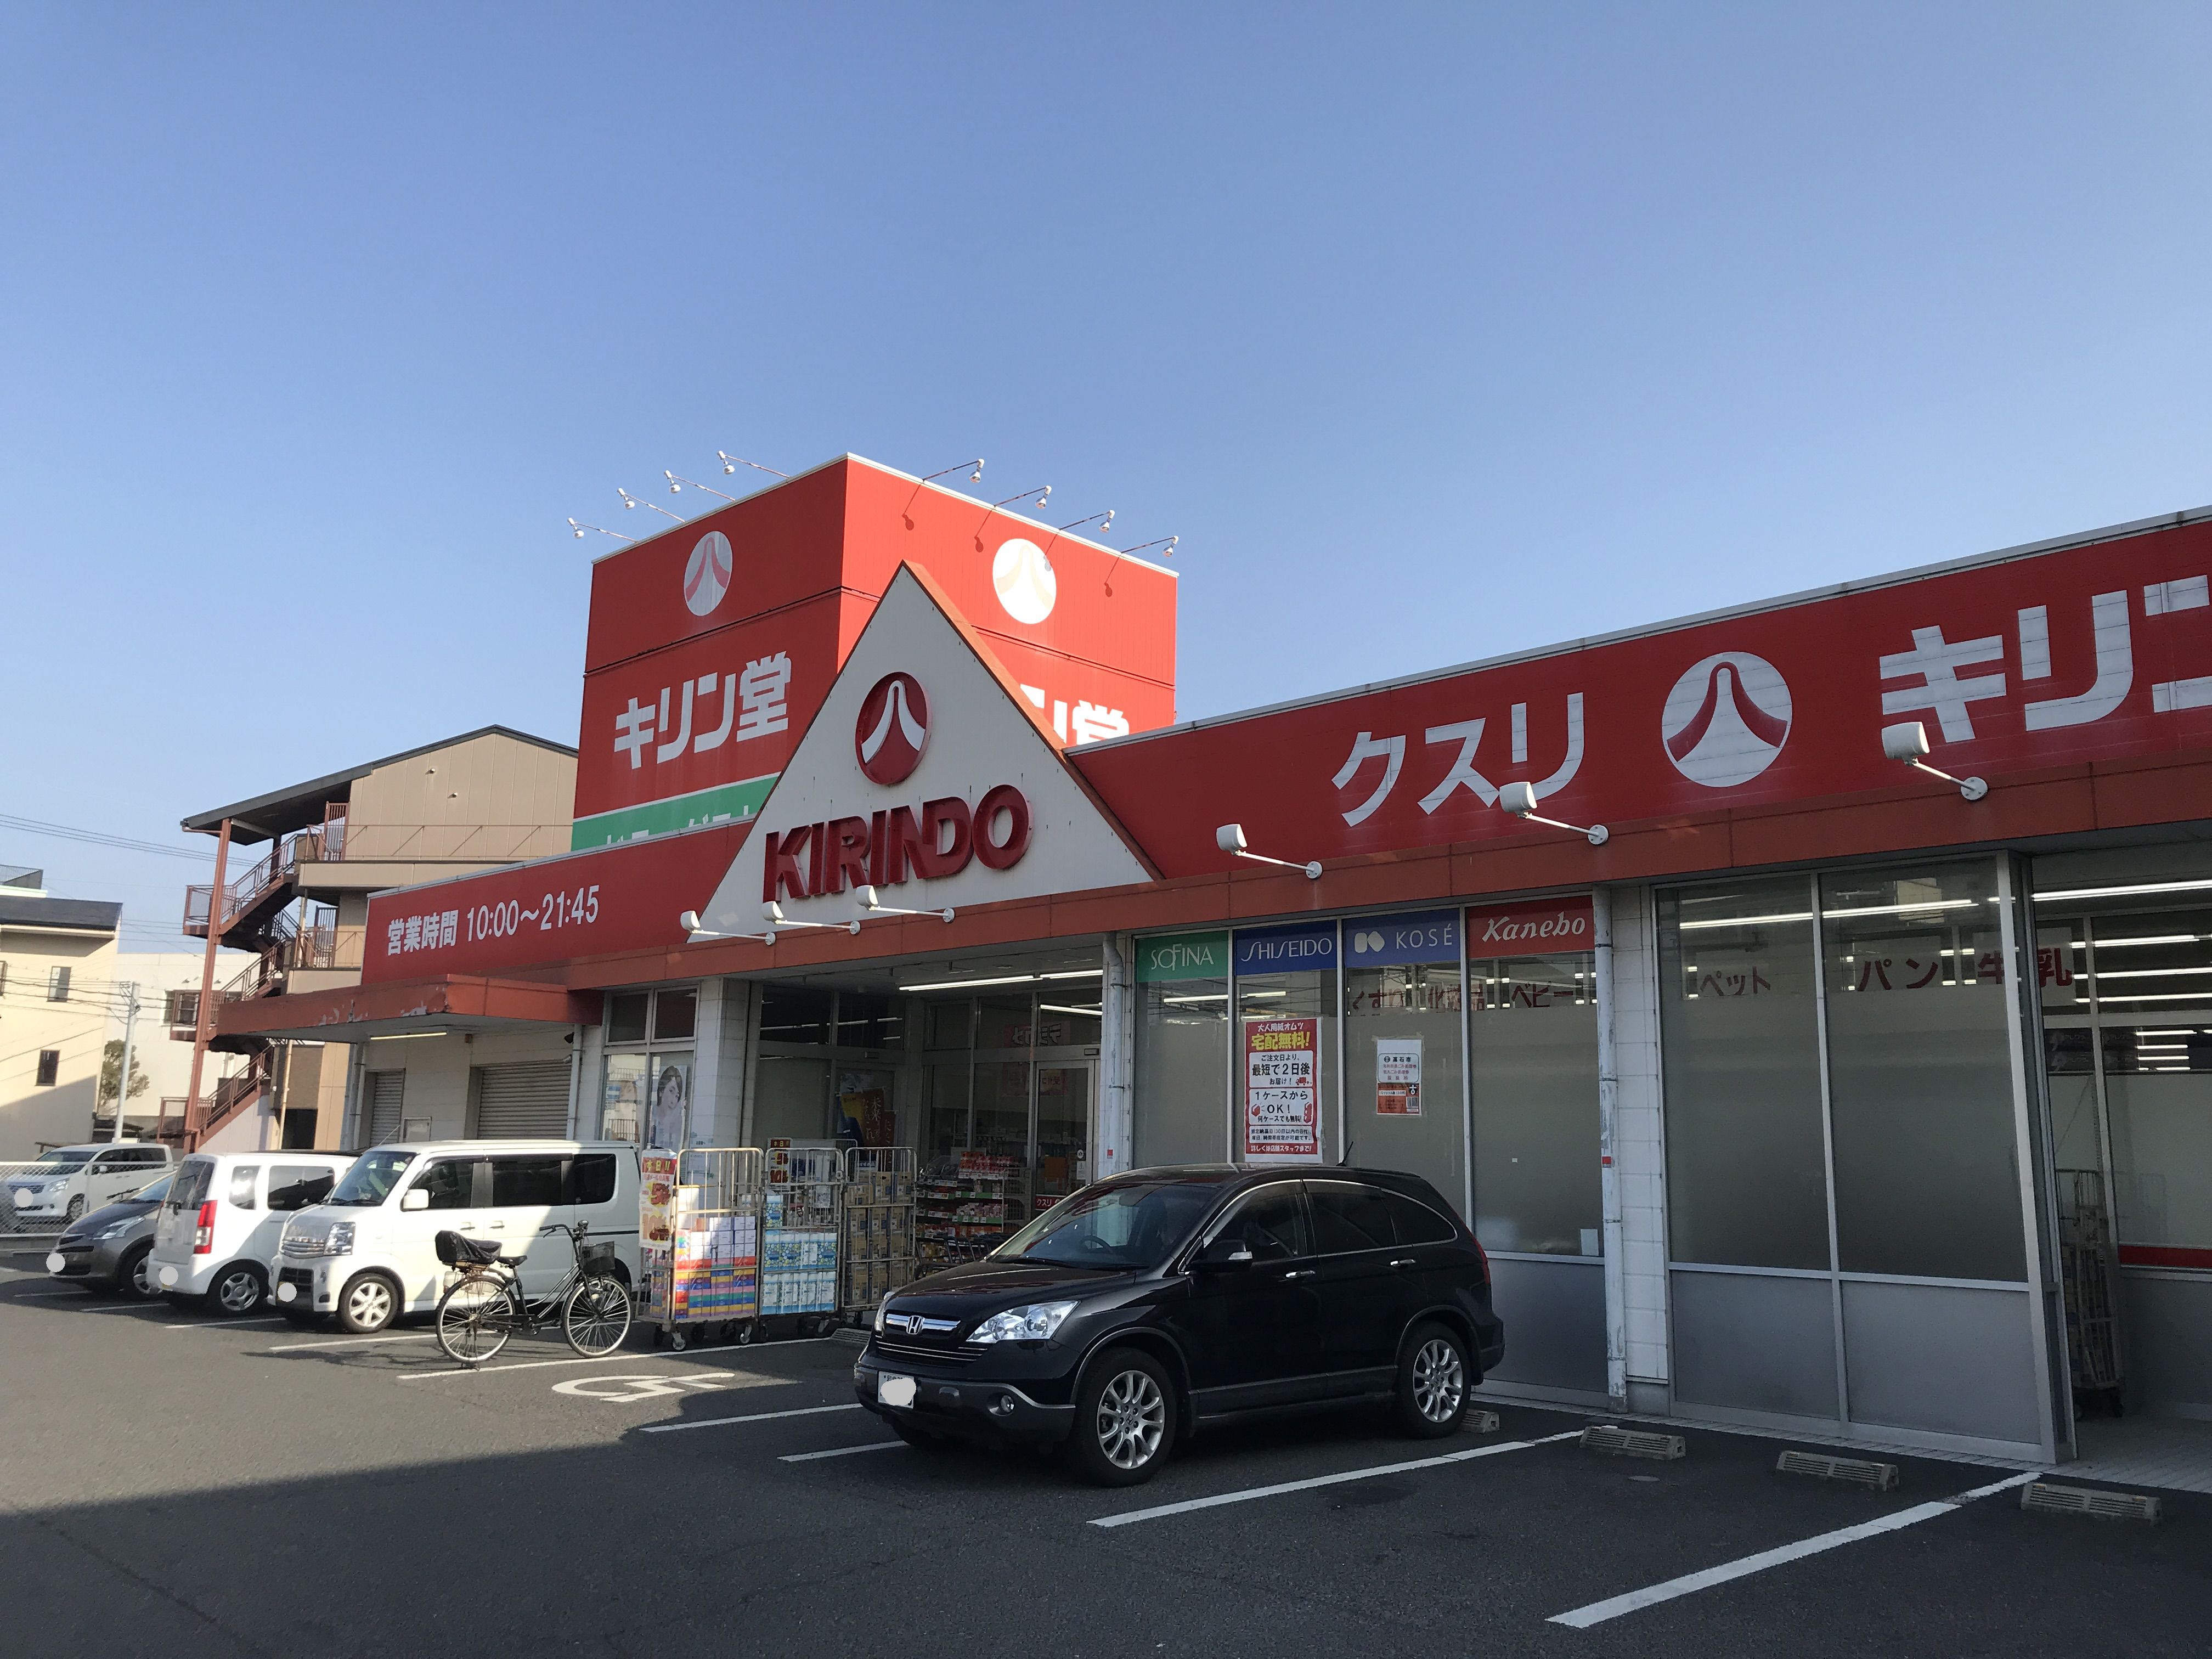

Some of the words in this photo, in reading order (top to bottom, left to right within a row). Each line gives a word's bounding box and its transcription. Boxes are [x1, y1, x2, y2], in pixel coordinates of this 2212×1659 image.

[614, 651, 792, 770] キリン堂
[1331, 692, 1585, 827] クスリ
[763, 785, 1034, 902] KIRINDO
[388, 910, 458, 956] 営業時間
[1395, 923, 1453, 950] KOSÉ
[1481, 912, 1586, 944] Kanebo
[1151, 945, 1214, 971] SOFINA
[1241, 937, 1333, 962] SHISEIDO
[1700, 966, 1771, 996] ペット
[1857, 958, 1939, 992] パン
[1257, 1022, 1304, 1032] 大人用紙オムツ
[1252, 1063, 1310, 1076] 最短で2日後
[1255, 1090, 1308, 1101] 1ケースから
